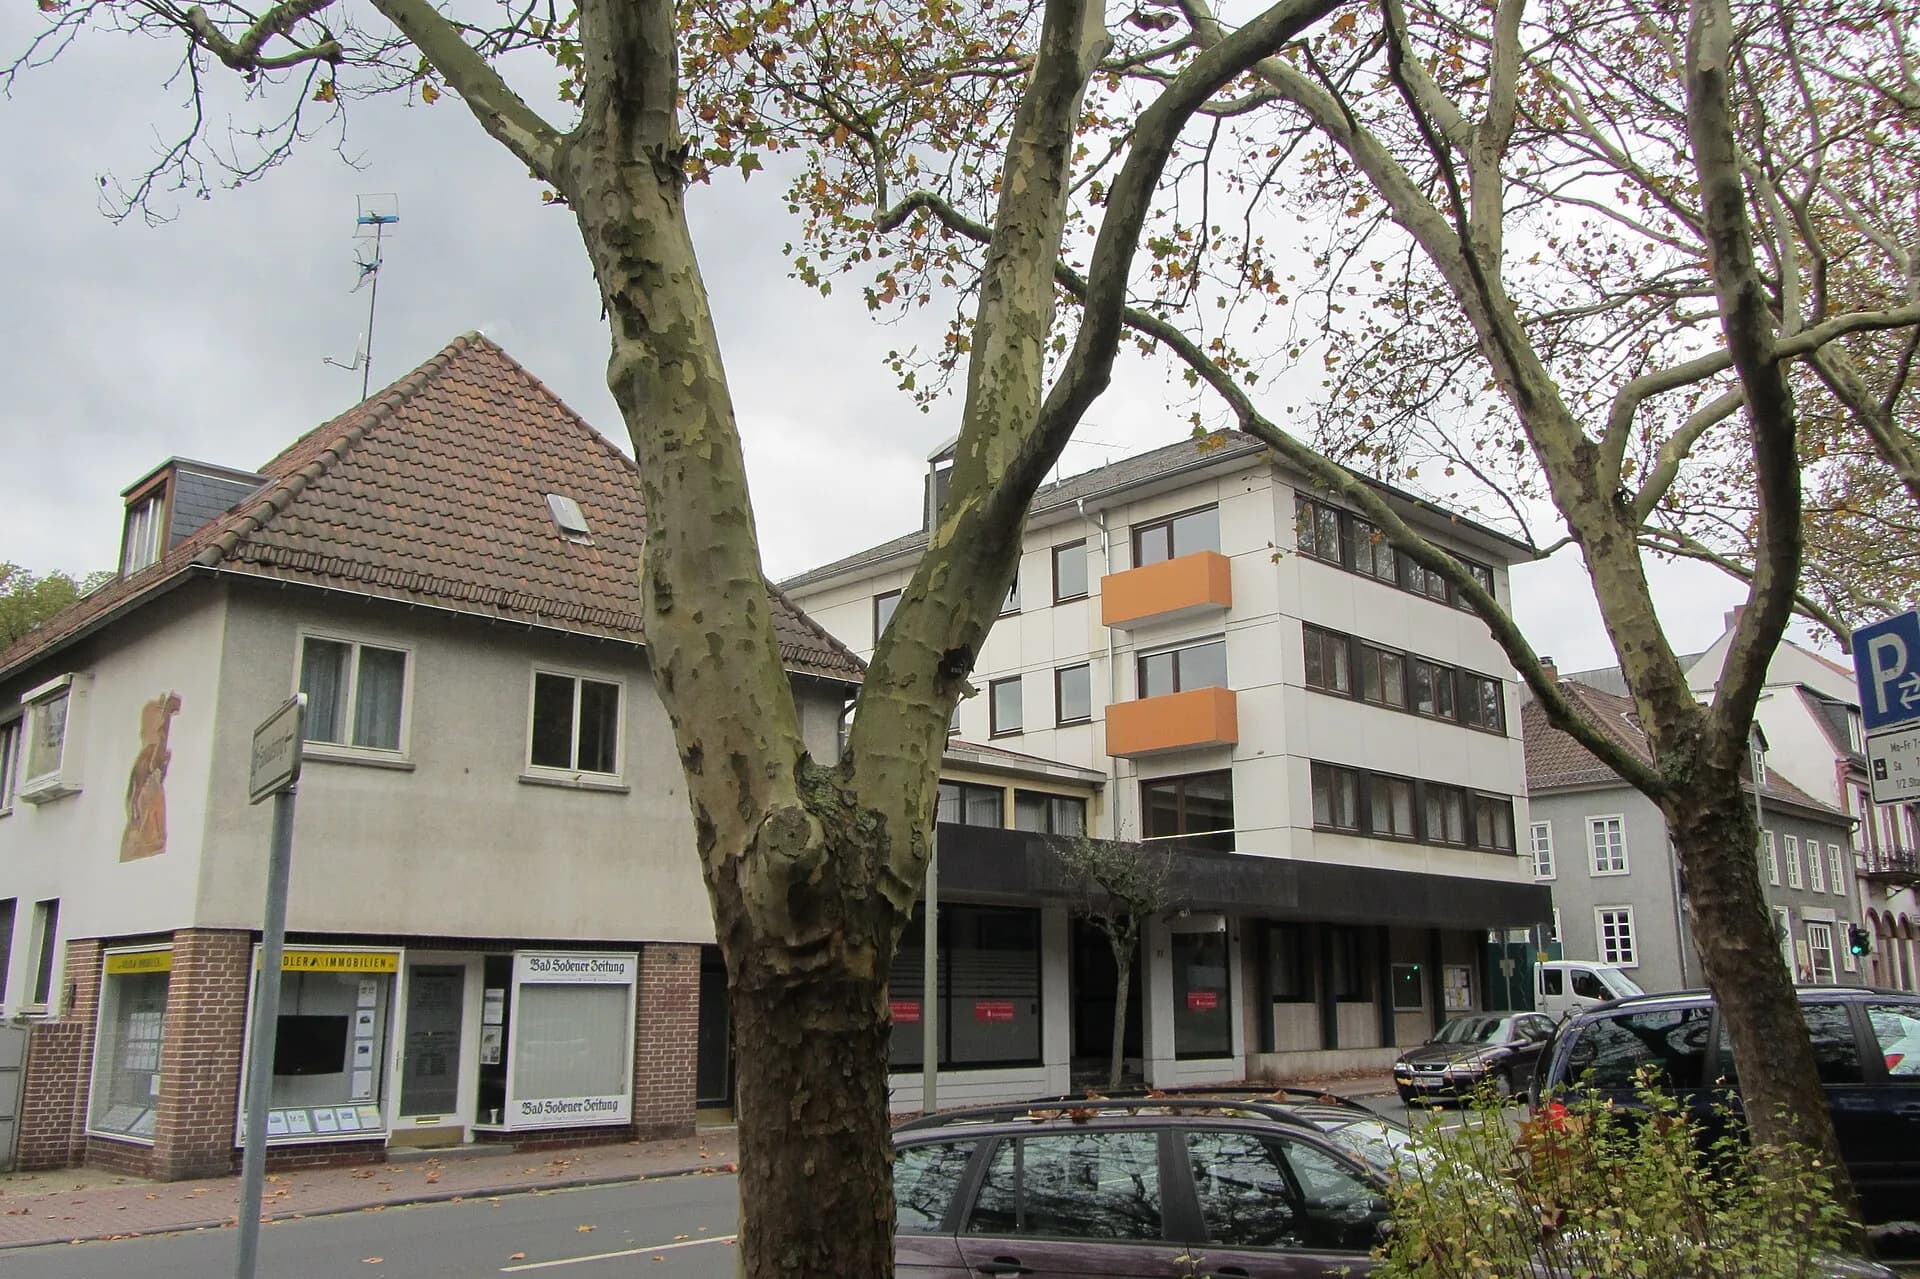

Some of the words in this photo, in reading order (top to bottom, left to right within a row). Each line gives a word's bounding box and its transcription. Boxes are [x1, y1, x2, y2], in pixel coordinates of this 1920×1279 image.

[1867, 632, 1907, 714] P
[282, 956, 308, 967] DLER
[325, 958, 386, 968] IMMOBILIEN
[529, 958, 551, 971] Bad
[551, 958, 590, 972] Sodener
[590, 960, 625, 974] Zeitung
[521, 1101, 543, 1115] Bad
[543, 1100, 583, 1114] Sodener
[584, 1098, 618, 1113] Zeitung
